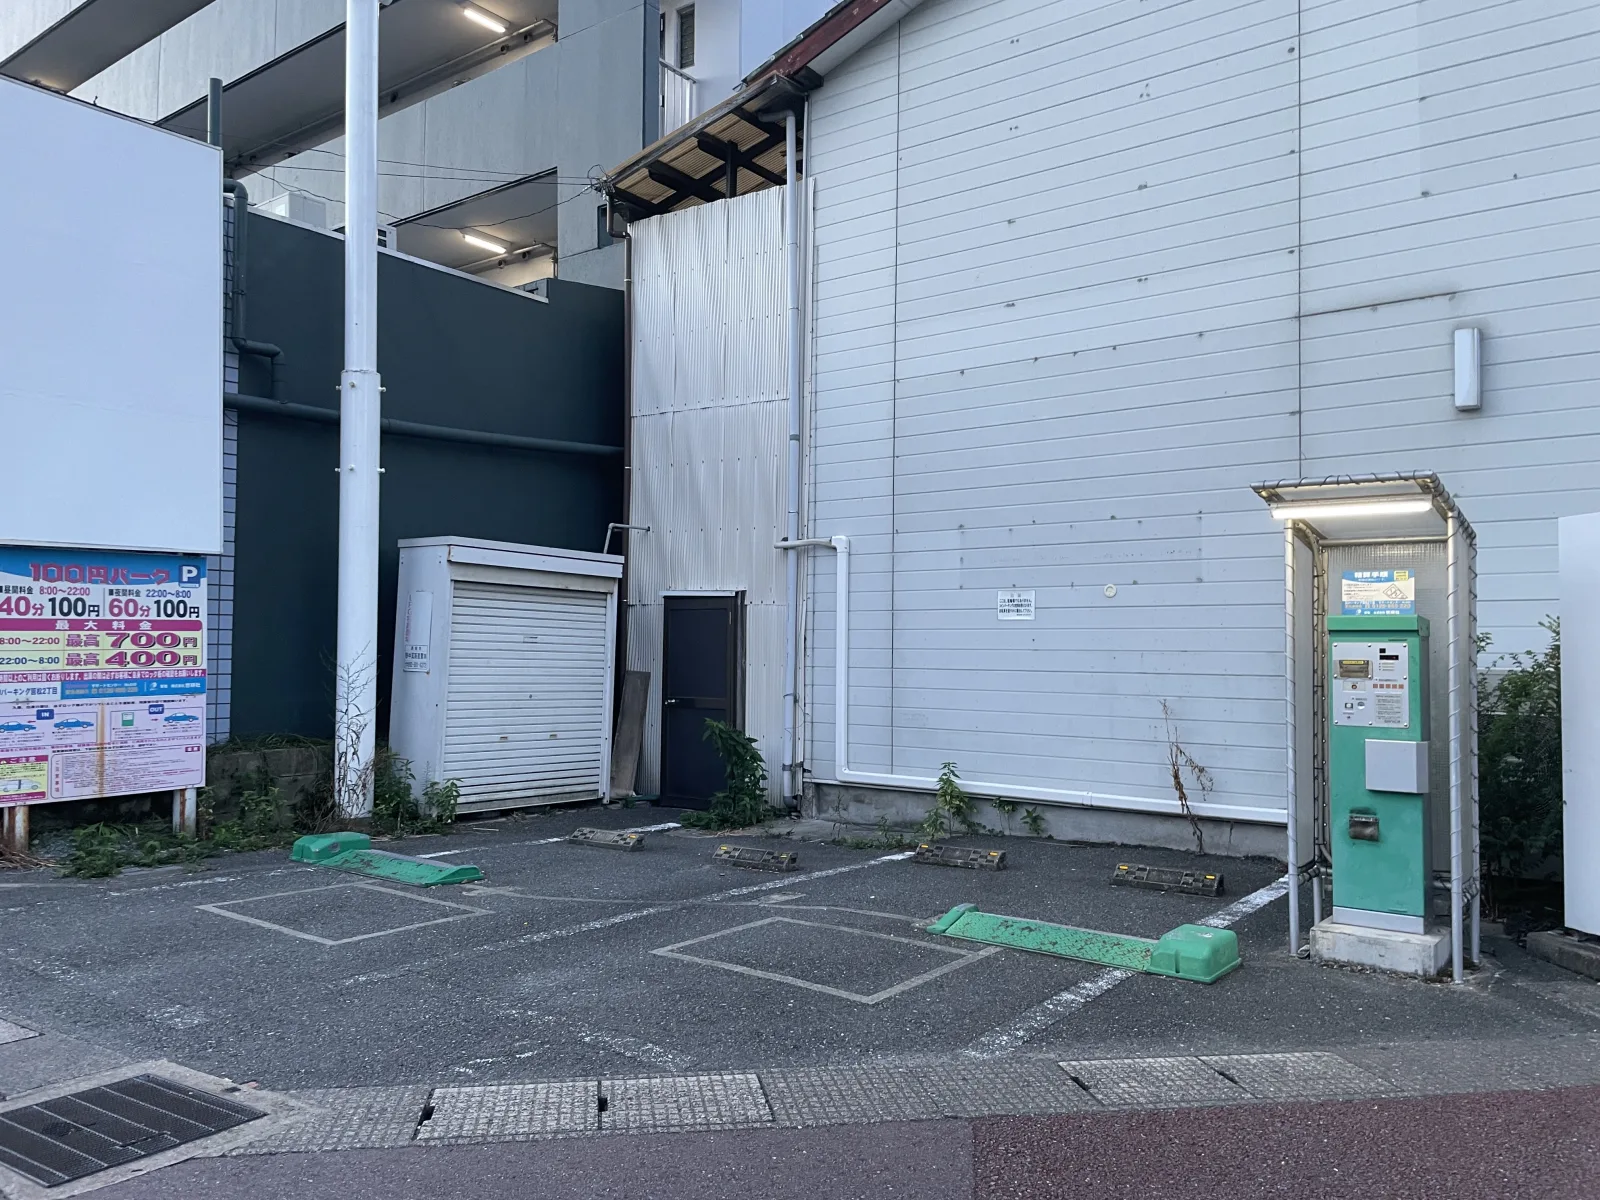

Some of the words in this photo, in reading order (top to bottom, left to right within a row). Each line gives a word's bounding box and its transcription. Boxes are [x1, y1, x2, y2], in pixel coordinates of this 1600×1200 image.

[29, 562, 171, 586] 100円パーク
[182, 565, 198, 582] P
[4, 585, 34, 595] 昼間料金
[114, 588, 141, 598] 夜間料金
[0, 595, 45, 617] 40分
[48, 596, 100, 618] 100円
[108, 598, 151, 618] 60分
[153, 599, 200, 618] 100円
[65, 633, 100, 648] 最高
[104, 632, 198, 649] 700円
[65, 652, 100, 667] 最高
[104, 650, 198, 668] 400円
